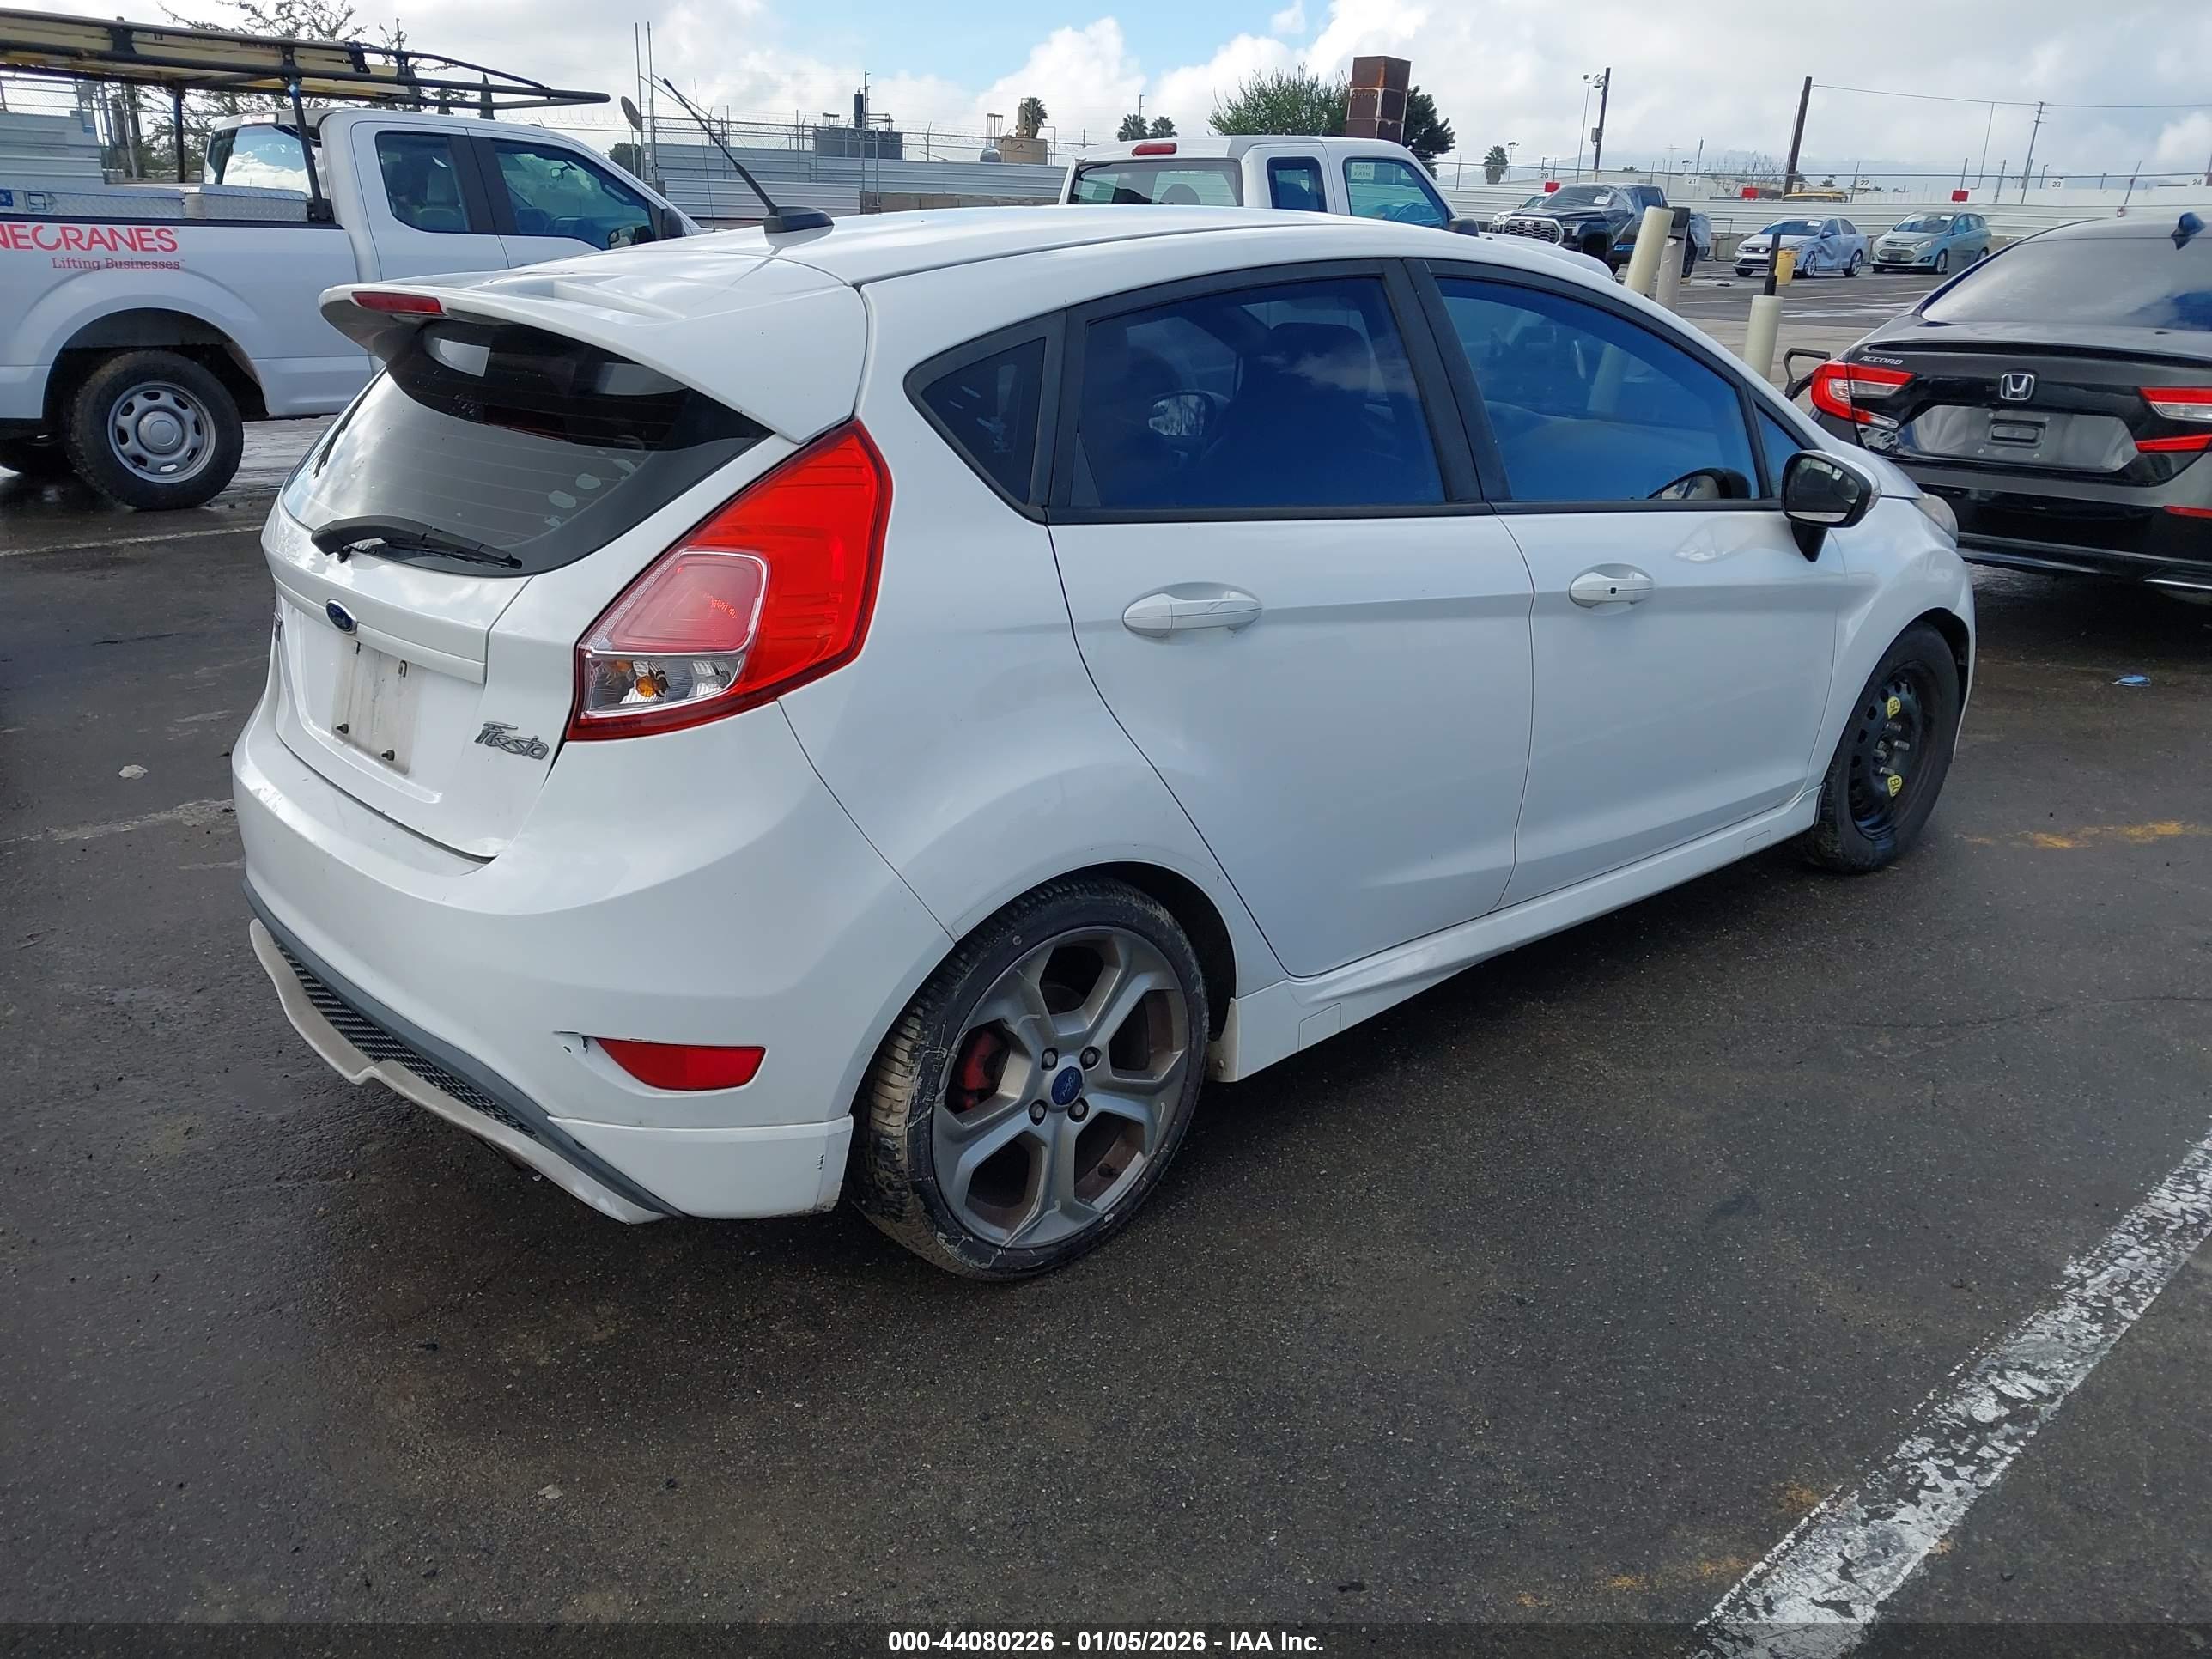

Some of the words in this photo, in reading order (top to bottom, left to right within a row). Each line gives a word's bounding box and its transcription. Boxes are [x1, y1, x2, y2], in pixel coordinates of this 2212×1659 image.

[51, 258, 100, 271] Lifting
[105, 258, 180, 270] Businesses
[1859, 356, 1904, 365] ACCORD
[475, 721, 550, 760] Fiesta
